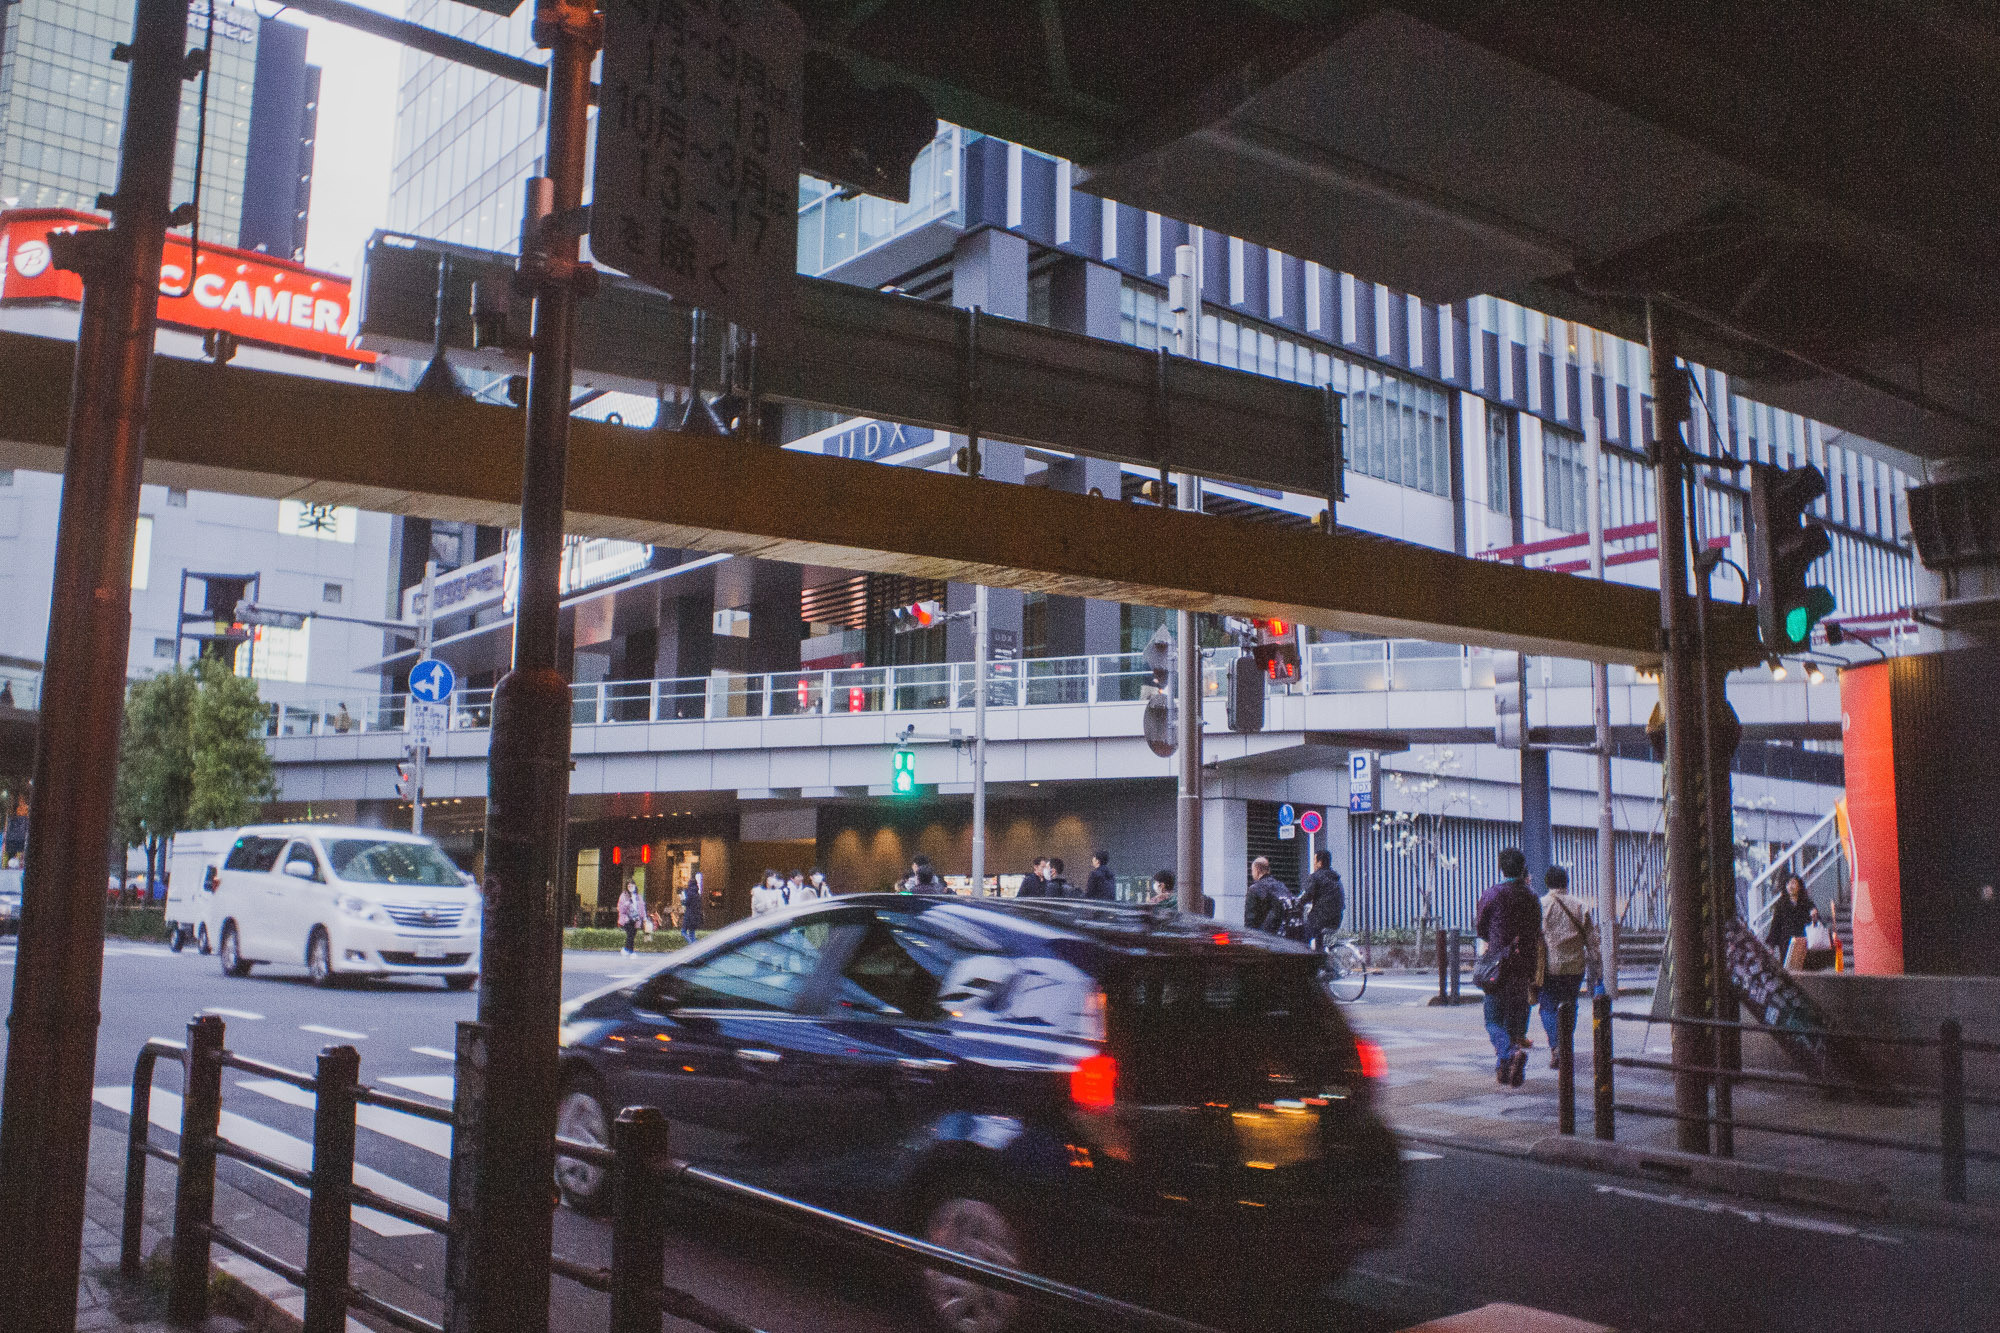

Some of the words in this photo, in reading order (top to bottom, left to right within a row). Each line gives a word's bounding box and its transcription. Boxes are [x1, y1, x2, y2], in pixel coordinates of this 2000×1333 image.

[838, 422, 906, 460] UDX
[1353, 756, 1366, 779] P
[1352, 783, 1370, 792] UDX
